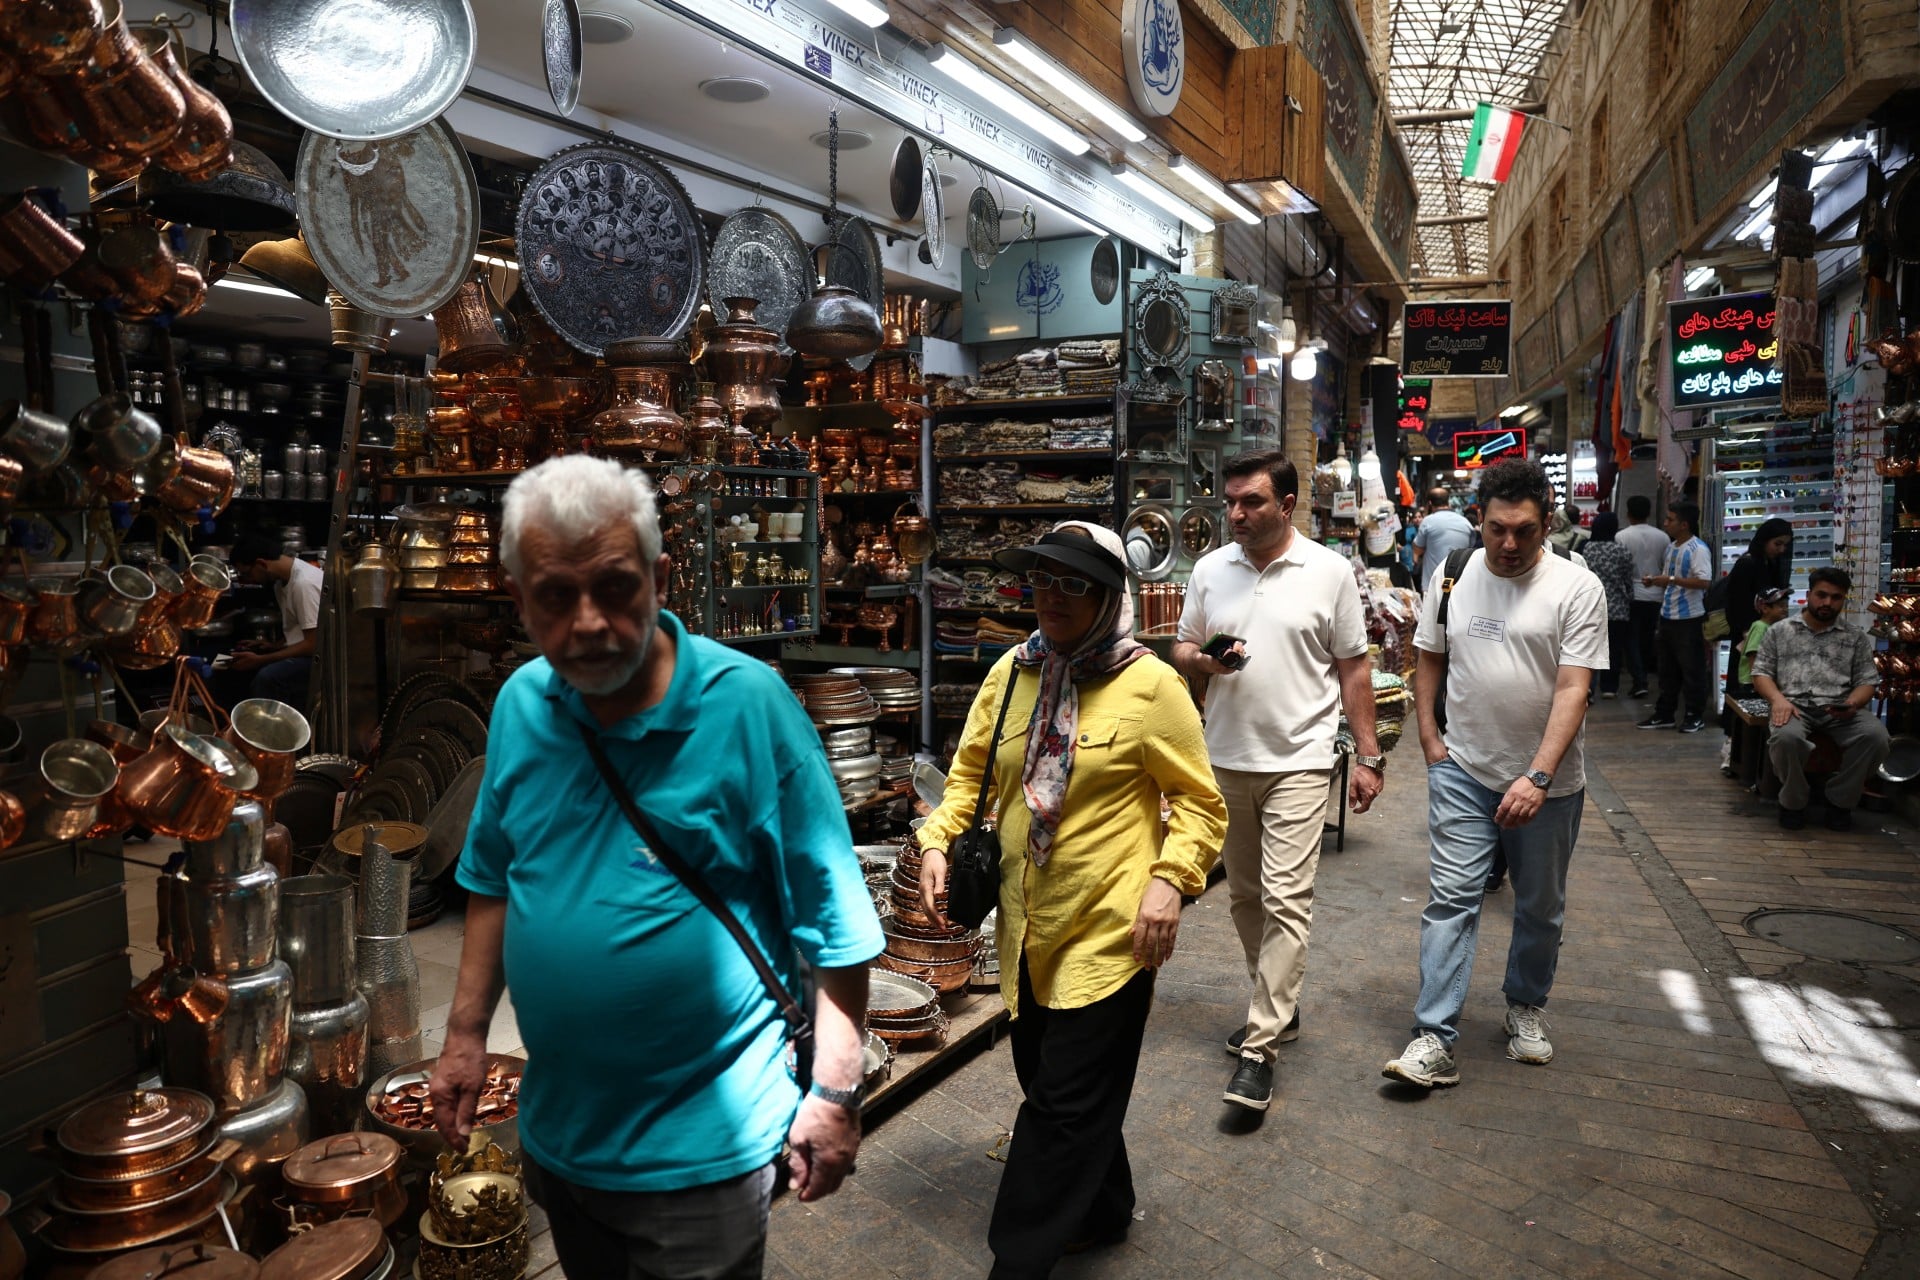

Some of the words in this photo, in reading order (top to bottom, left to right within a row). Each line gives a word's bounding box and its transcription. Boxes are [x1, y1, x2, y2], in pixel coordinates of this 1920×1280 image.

[822, 27, 865, 67] VINEX
[902, 74, 939, 108] VINEX
[969, 112, 1000, 142] VINEX
[1026, 146, 1053, 171] VINEX
[1408, 308, 1436, 328] تاک
[1437, 307, 1466, 332] تیک
[1468, 306, 1508, 327] ساعت
[1679, 312, 1710, 338] های
[1713, 308, 1754, 330] عینک
[1425, 335, 1488, 354] تعمیرات
[1724, 340, 1756, 363] طبی
[1409, 357, 1452, 375] باطری
[1481, 357, 1503, 374] بند
[1732, 368, 1764, 393] های
